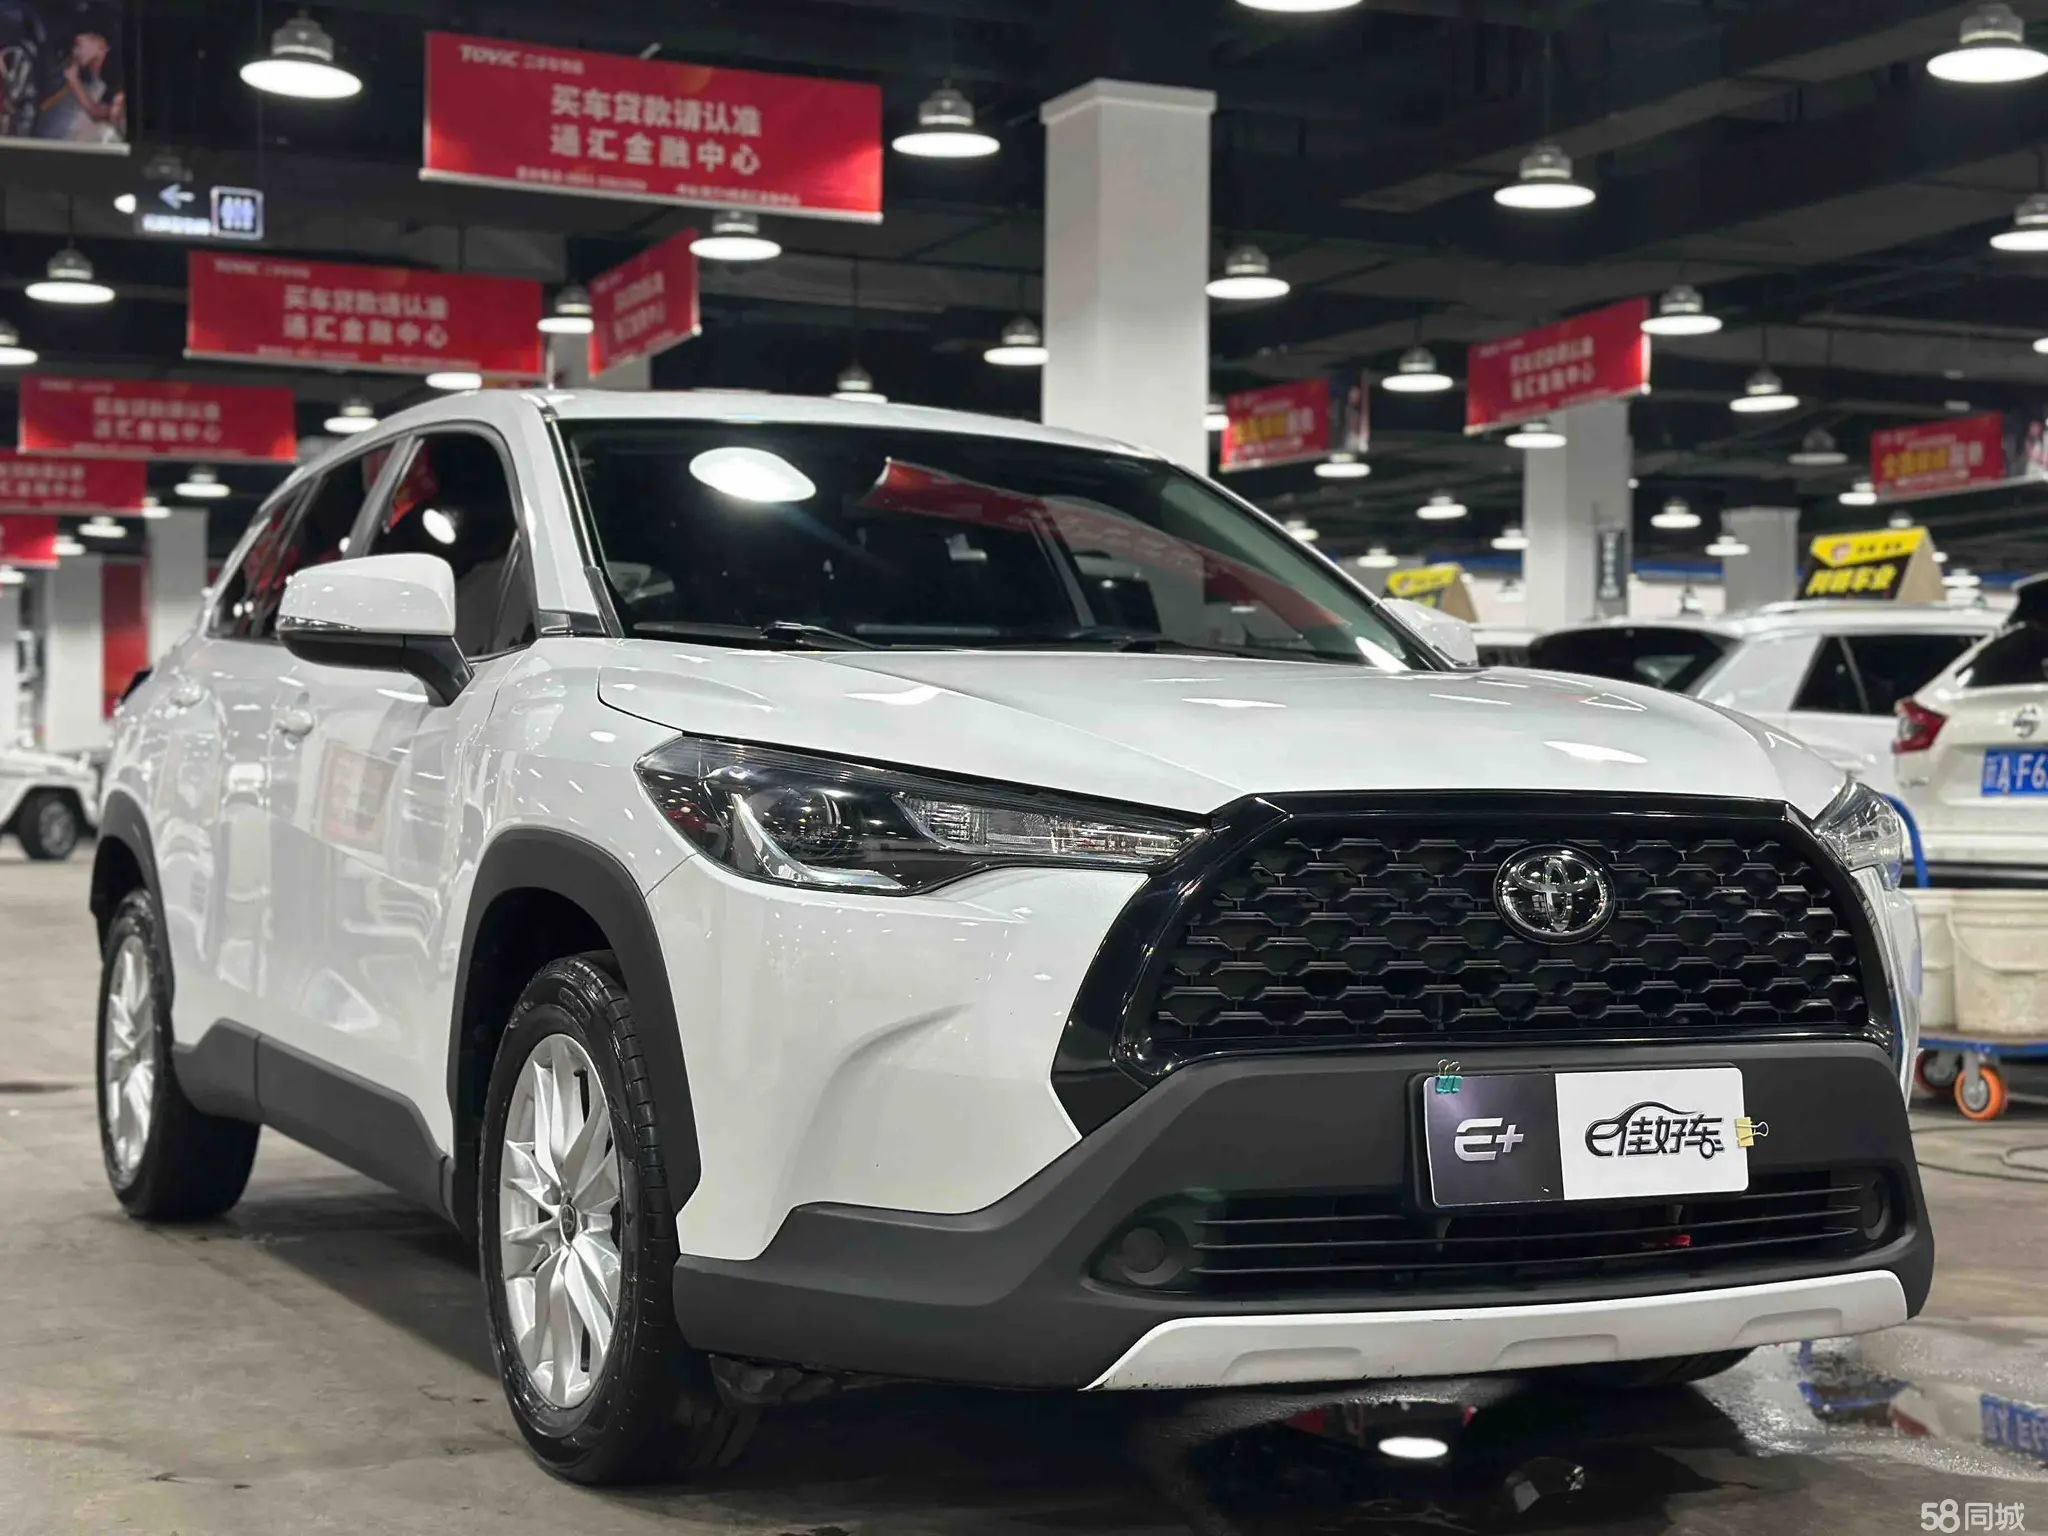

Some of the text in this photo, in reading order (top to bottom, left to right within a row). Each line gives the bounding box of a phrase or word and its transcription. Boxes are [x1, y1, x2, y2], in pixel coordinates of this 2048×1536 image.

[551, 83, 761, 137] 买车贷款请认准
[551, 123, 760, 175] 通汇金融中心
[1985, 752, 2048, 793] AF6
